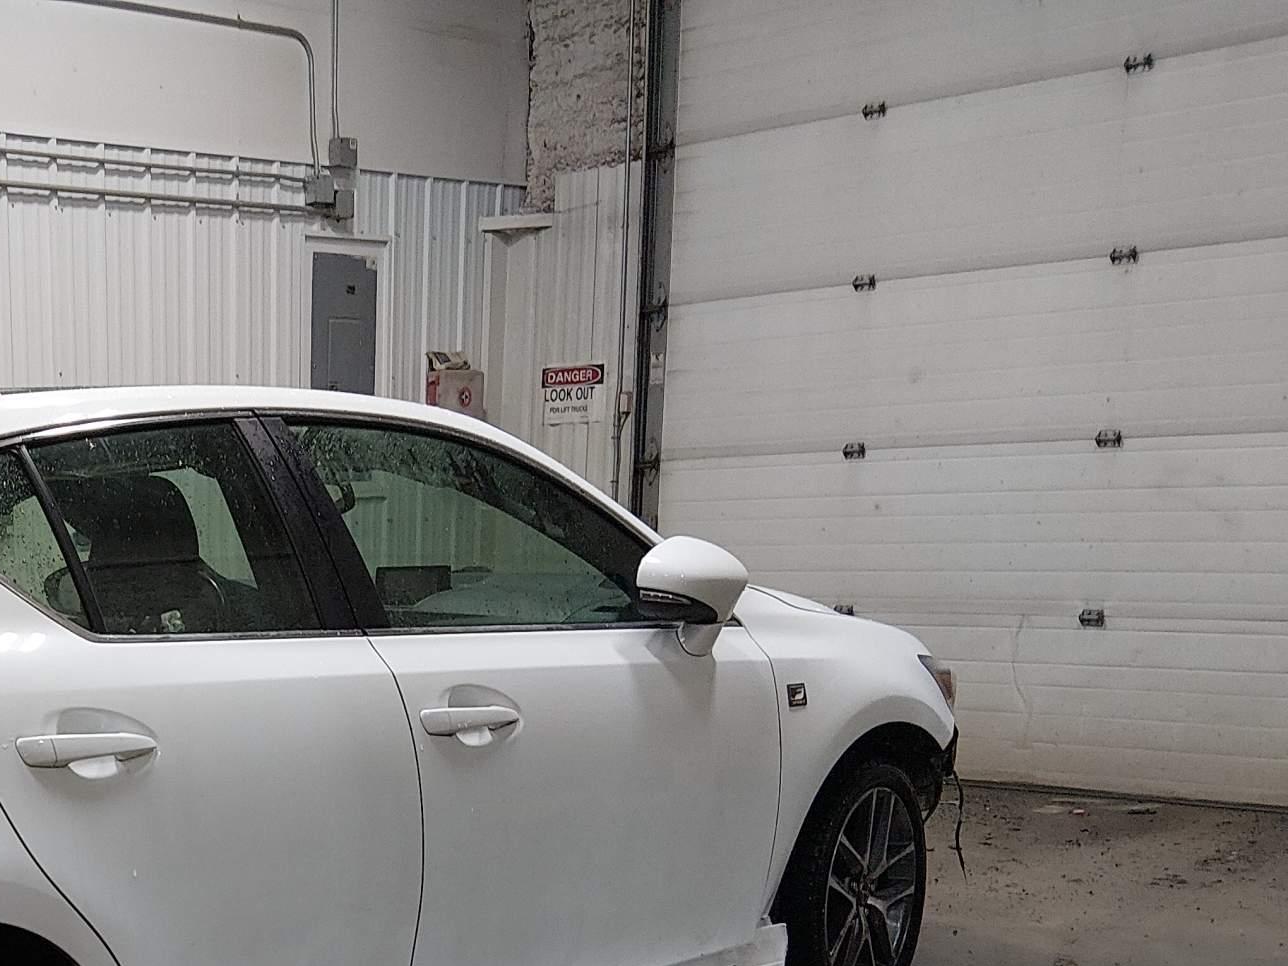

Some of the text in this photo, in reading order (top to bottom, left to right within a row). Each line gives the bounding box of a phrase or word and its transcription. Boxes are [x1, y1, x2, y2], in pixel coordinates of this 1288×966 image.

[547, 370, 593, 383] DANGER
[544, 386, 595, 402] LOOK OUT
